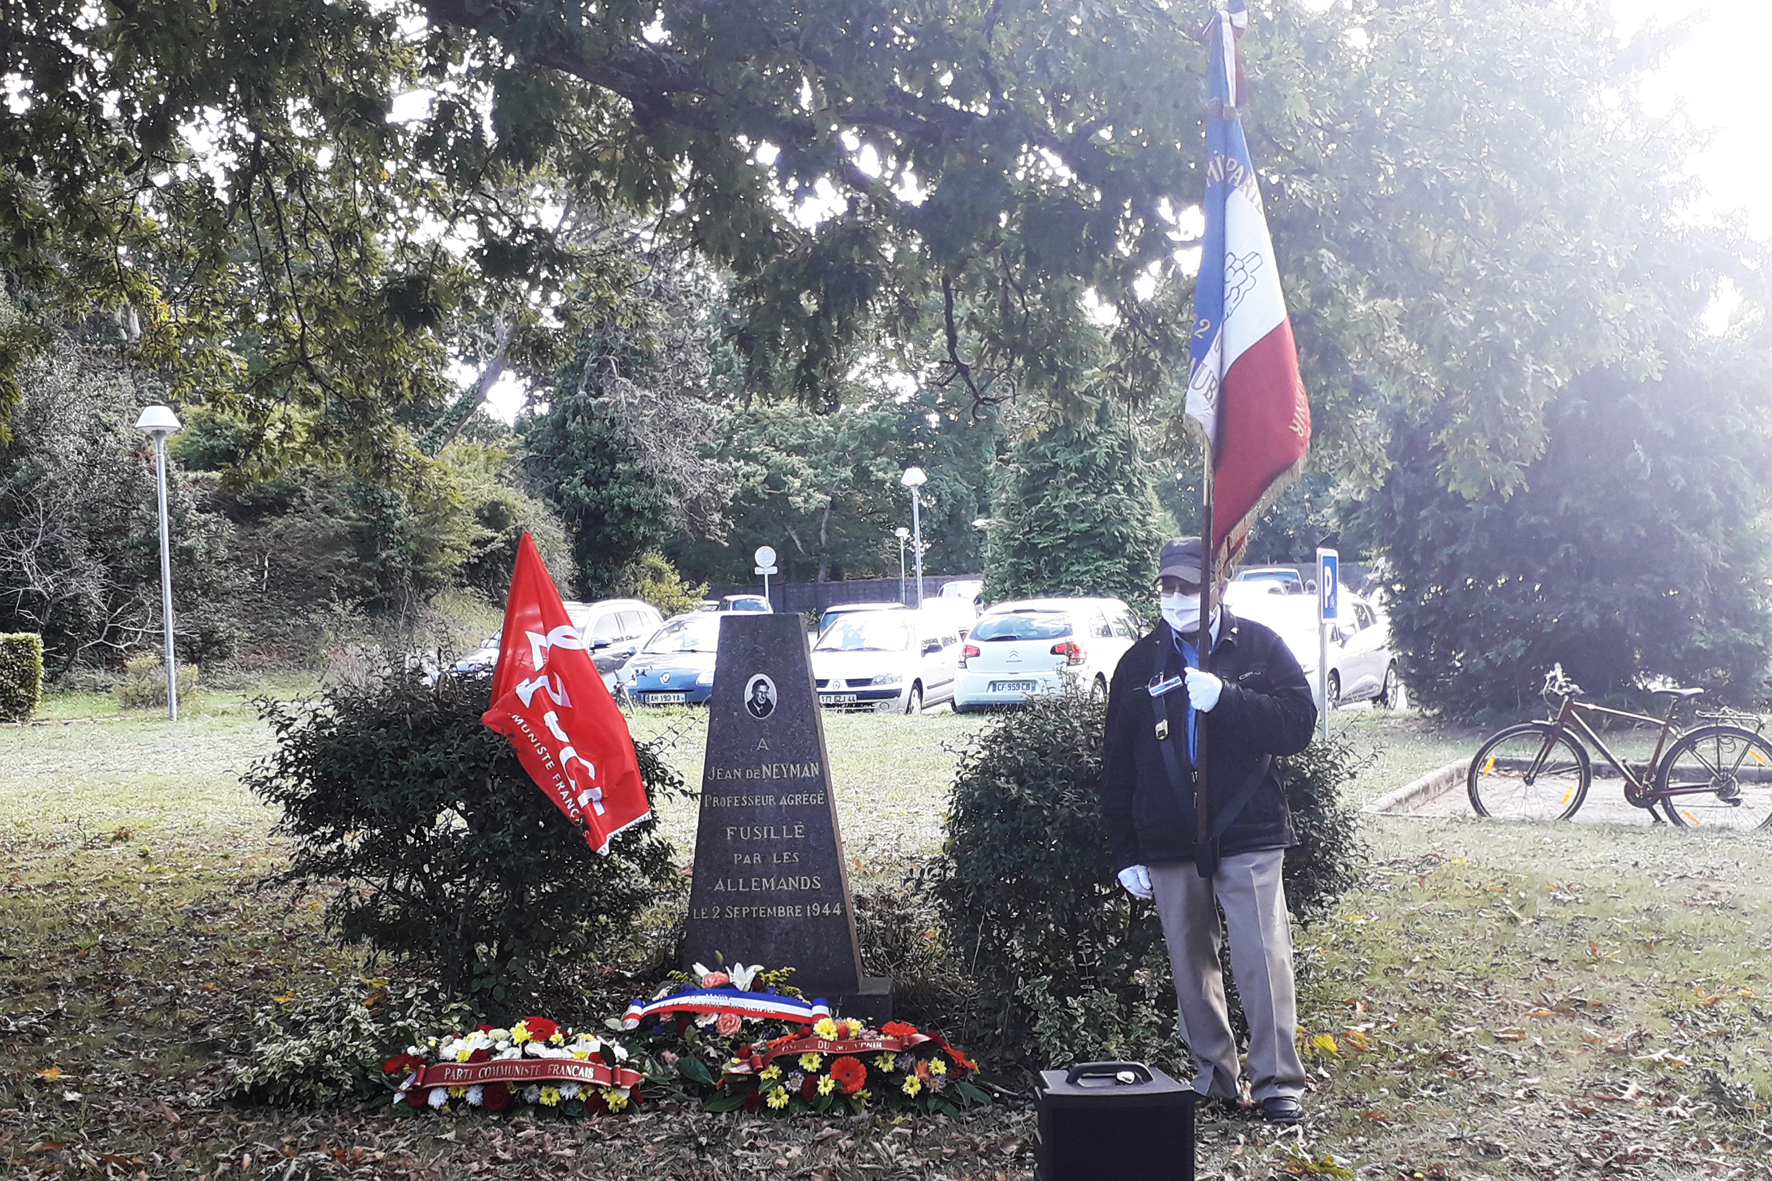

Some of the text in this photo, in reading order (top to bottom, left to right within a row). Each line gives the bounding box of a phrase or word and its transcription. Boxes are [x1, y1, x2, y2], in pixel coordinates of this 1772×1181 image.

[1324, 565, 1333, 609] P
[756, 737, 770, 751] A
[708, 766, 742, 781] JEAN
[762, 762, 820, 779] NEYMAN
[704, 790, 825, 808] PROFESSEUR AGRÉGÉ
[726, 822, 806, 841] FUSILLÉ
[733, 852, 800, 865] PAR LES
[713, 875, 822, 892] ALLEMANDS
[693, 902, 842, 919] LE 2 SEPTEMBRE 1944
[817, 1040, 831, 1050] DU
[443, 1067, 473, 1081] PARTI
[478, 1064, 541, 1079] COMMUNISTE
